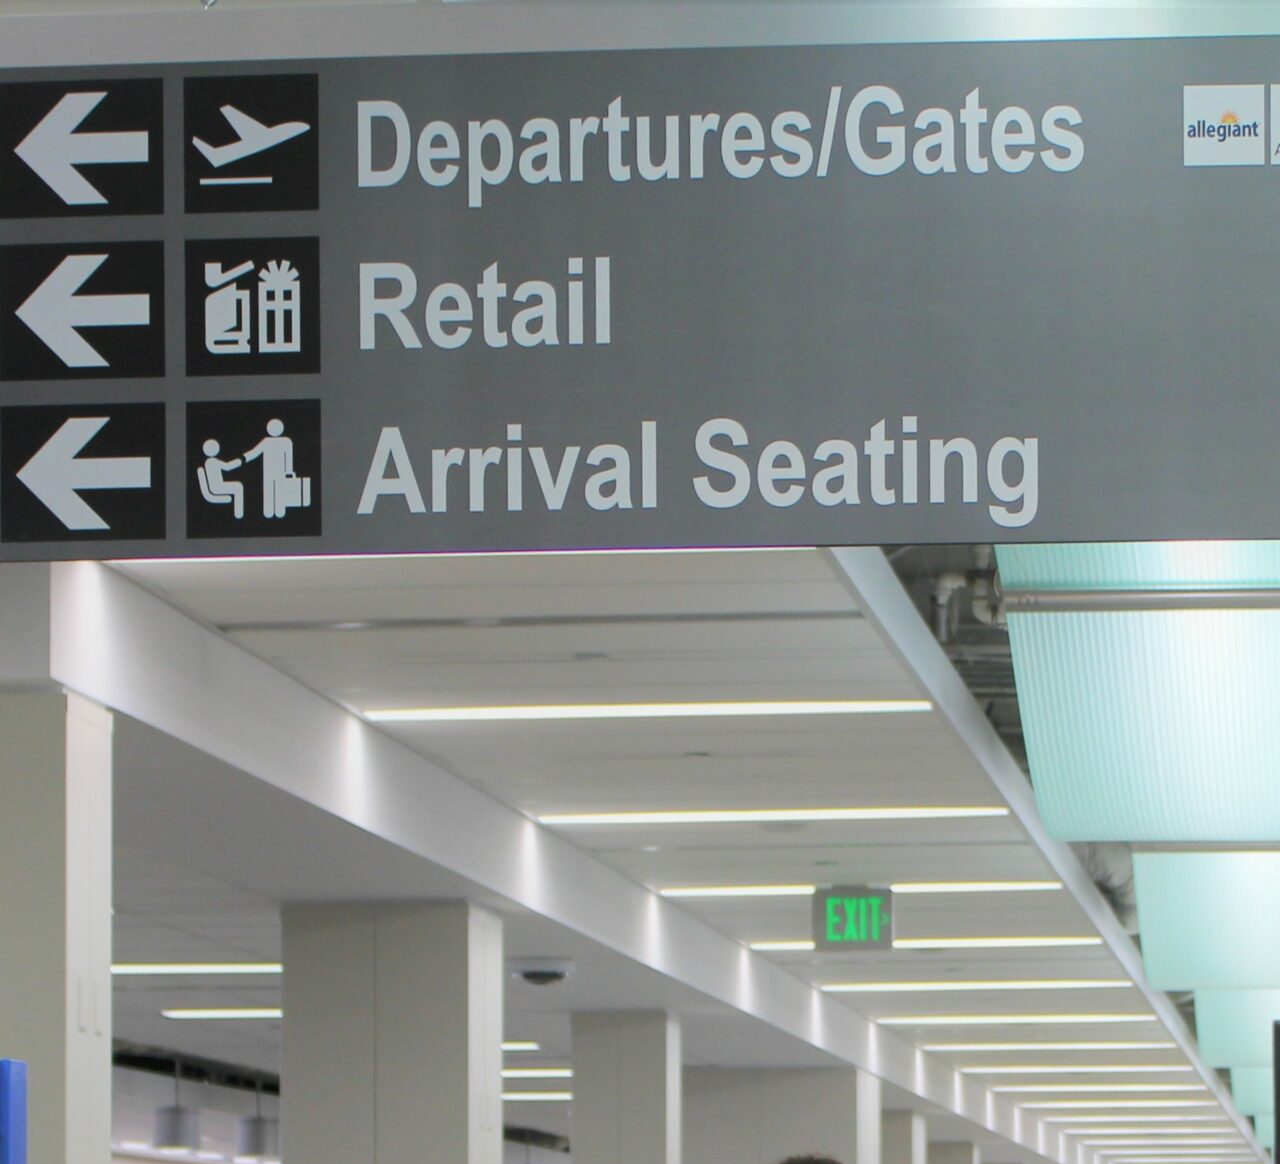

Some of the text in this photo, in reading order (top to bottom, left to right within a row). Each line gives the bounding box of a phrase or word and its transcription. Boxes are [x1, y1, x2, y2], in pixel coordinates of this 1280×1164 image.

[357, 86, 1086, 208] Departures/Gates
[1187, 120, 1259, 142] allegiant
[359, 256, 611, 350] Retail
[356, 415, 1039, 528] Arrival Seating
[825, 896, 884, 942] EXIT
